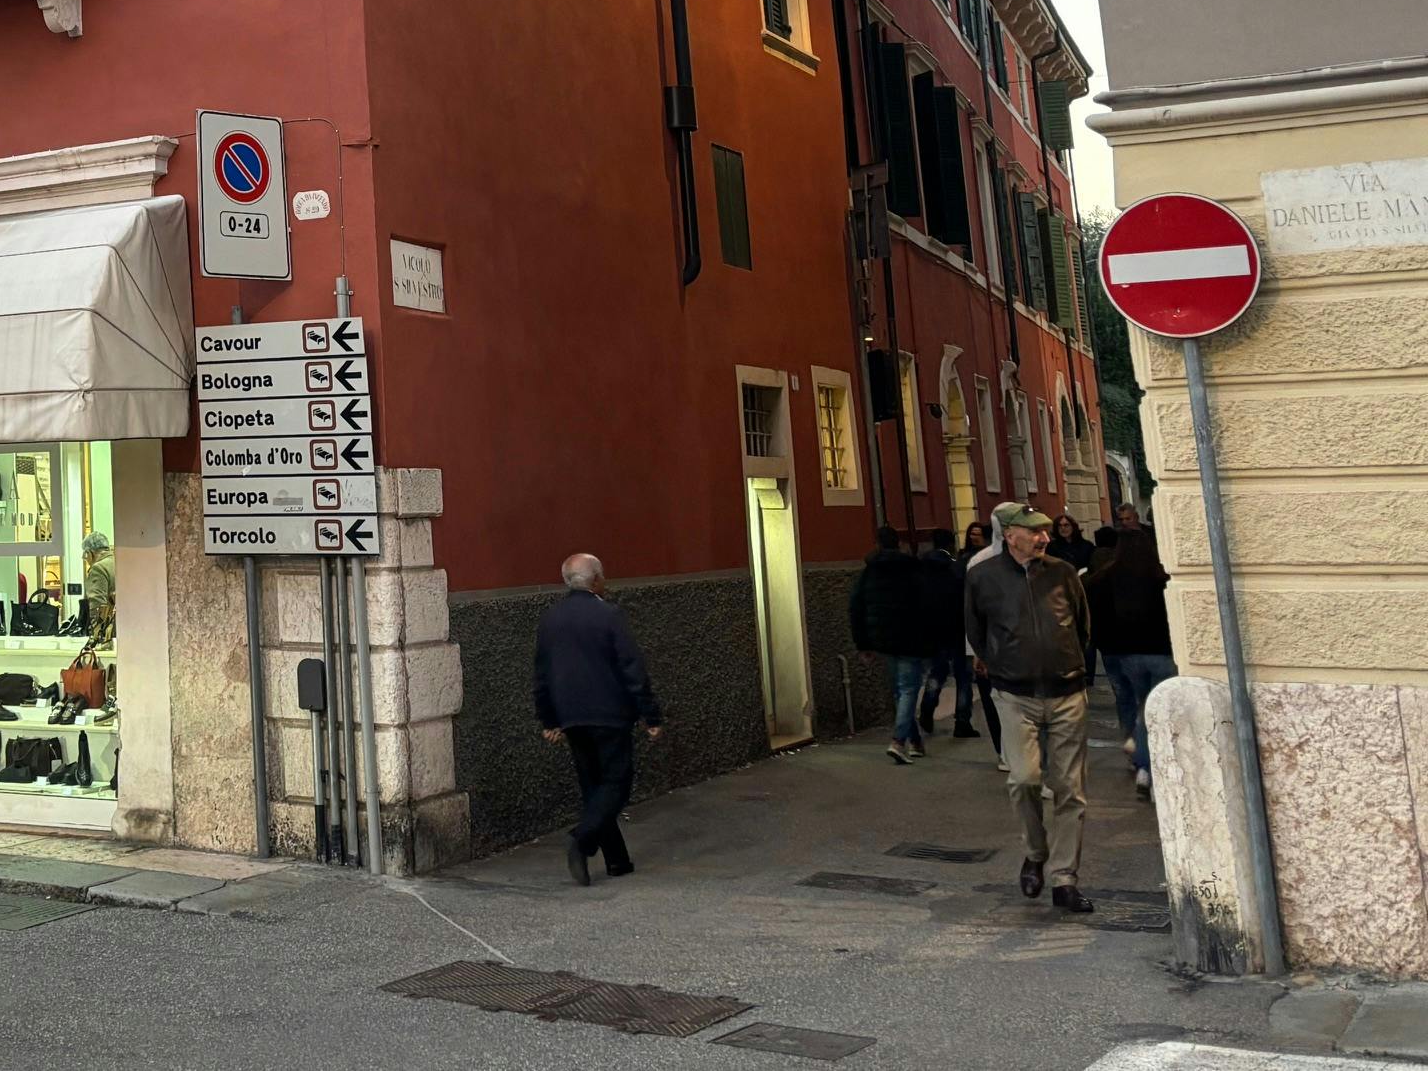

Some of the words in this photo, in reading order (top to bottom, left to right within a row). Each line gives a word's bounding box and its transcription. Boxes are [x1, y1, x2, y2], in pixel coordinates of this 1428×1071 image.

[1340, 174, 1385, 193] VIA
[1274, 201, 1371, 227] DANIELE
[1383, 196, 1428, 219] MA
[228, 215, 261, 234] 0-24
[402, 253, 431, 273] VICOLO
[200, 336, 262, 352] Cavour
[202, 373, 274, 391] Bologna
[204, 410, 275, 430] Ciopeta
[205, 448, 262, 466] Colomba
[267, 447, 303, 465] d'Oro
[206, 488, 269, 507] Europa
[208, 527, 277, 545] Torcolo
